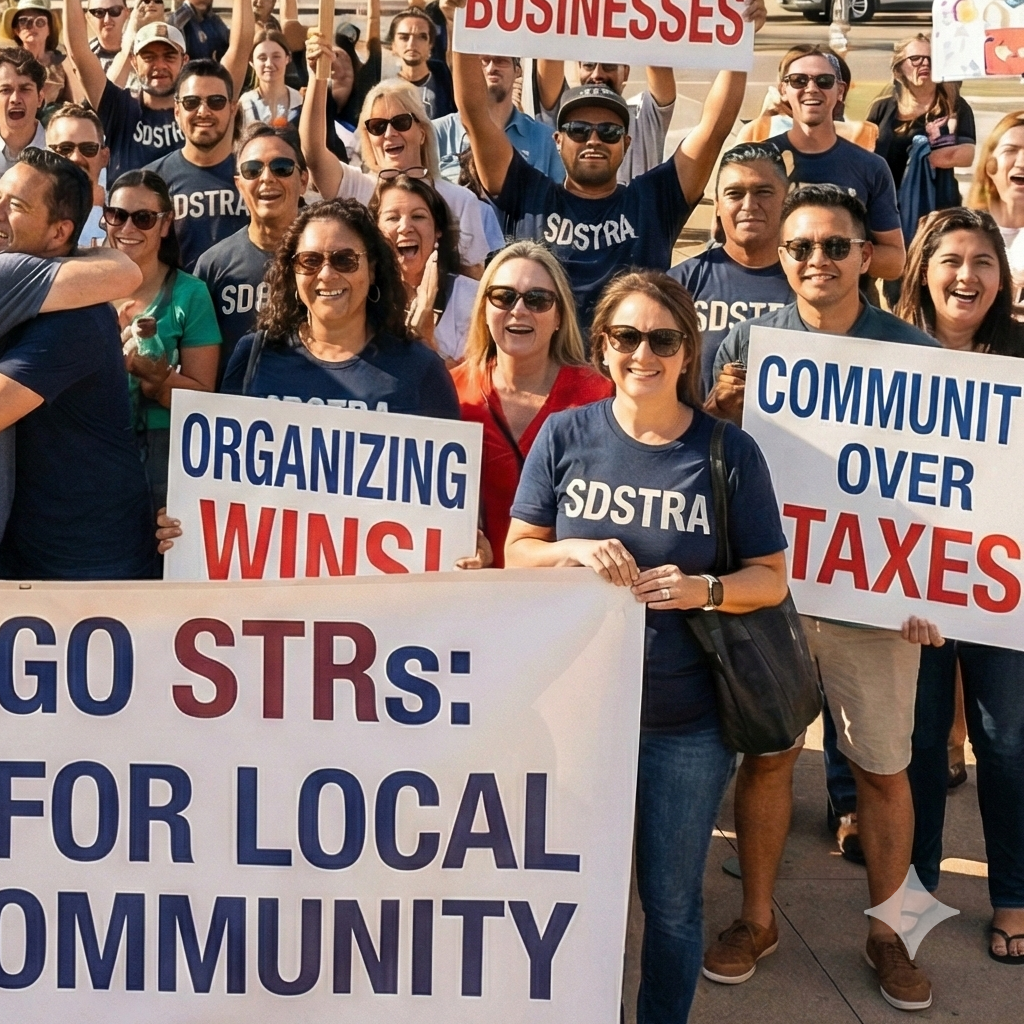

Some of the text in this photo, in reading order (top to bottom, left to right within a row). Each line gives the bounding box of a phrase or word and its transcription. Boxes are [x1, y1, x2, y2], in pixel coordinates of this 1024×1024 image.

[544, 212, 639, 251] SDSTRA
[758, 355, 1022, 446] COMMUNIT
[181, 413, 467, 510] ORGANIZING
[564, 478, 711, 535] SDSTRA
[837, 442, 974, 511] OVER
[783, 503, 1022, 614] TAXES
[172, 617, 471, 726] STRs:
[236, 766, 581, 872] LOCAL
